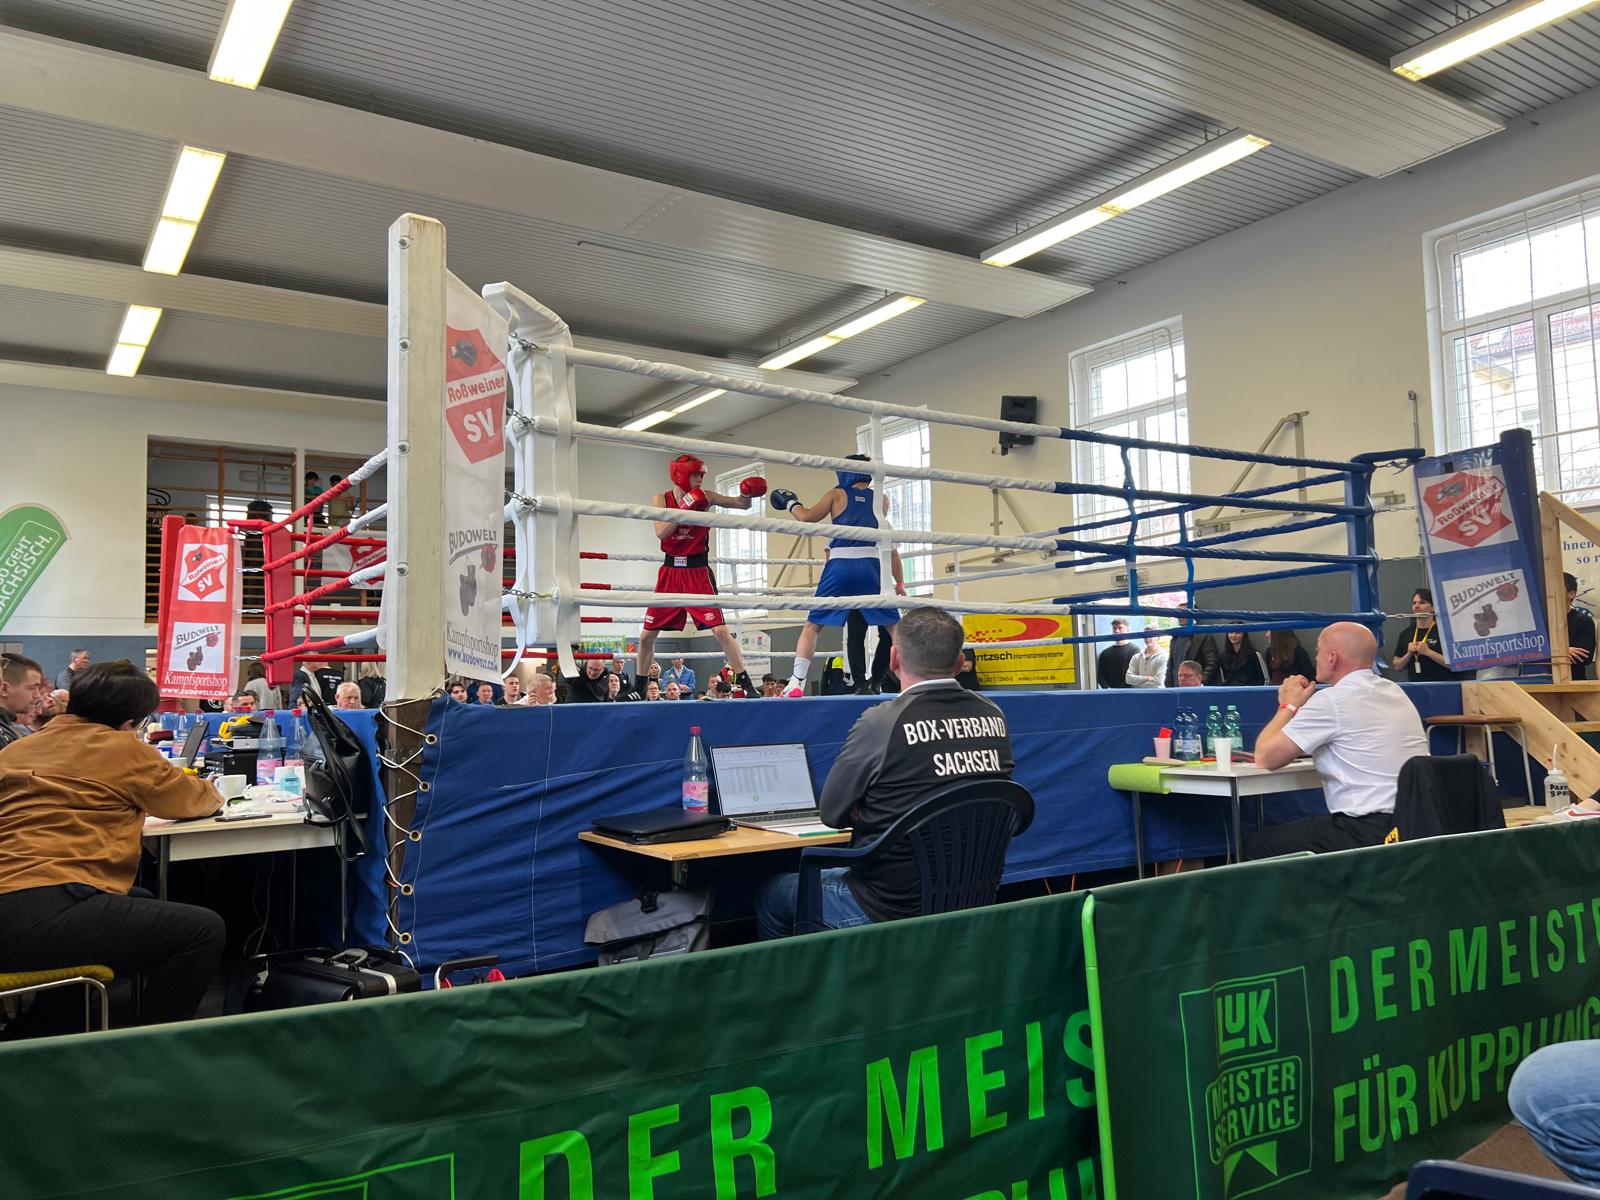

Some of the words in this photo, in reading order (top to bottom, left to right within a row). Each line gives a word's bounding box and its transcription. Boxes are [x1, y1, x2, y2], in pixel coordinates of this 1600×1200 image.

[448, 376, 505, 402] Roßweiner
[464, 407, 495, 443] SV
[1459, 504, 1492, 536] SV
[5, 535, 32, 568] GEHT
[449, 529, 497, 555] BUDOWELT
[1577, 556, 1590, 564] so
[197, 573, 213, 592] SV
[1450, 572, 1516, 610] BUDOWELT
[176, 625, 219, 645] BUDOWELT
[447, 621, 499, 662] Kampfsportshop
[1453, 633, 1544, 660] Kampfsportshop
[164, 671, 228, 690] Kampfsportshop
[903, 716, 1006, 745] BOX-VERBAND
[933, 749, 1001, 776] SACHSEN
[1329, 938, 1436, 1034] DER
[1333, 1054, 1419, 1163] FÜR
[1215, 1095, 1296, 1157] SERVICE
